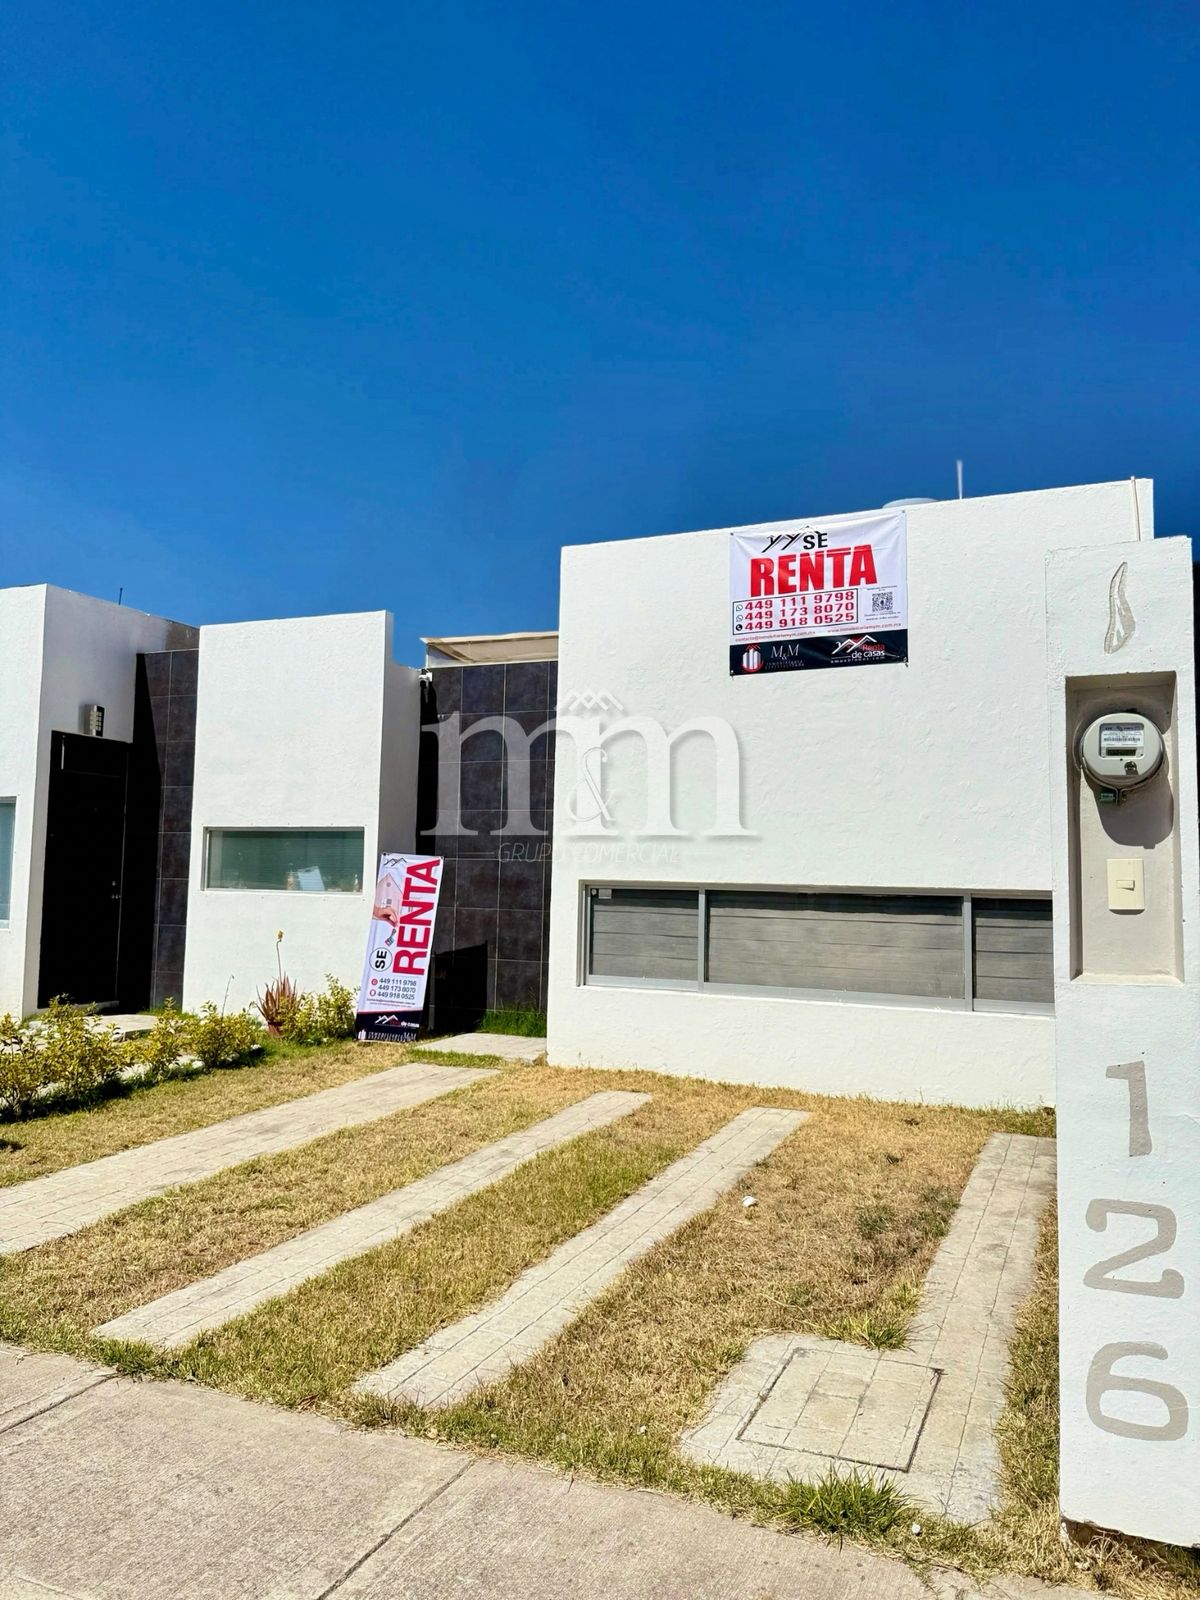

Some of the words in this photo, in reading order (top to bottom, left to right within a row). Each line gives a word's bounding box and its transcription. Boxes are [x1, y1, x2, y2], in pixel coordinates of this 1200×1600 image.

[803, 532, 828, 550] SE
[751, 544, 877, 597] RENTA
[745, 600, 773, 611] 449
[780, 596, 807, 607] 111
[814, 591, 854, 604] 9798
[745, 610, 773, 621] 449
[780, 607, 808, 618] 173
[814, 602, 854, 615] 8070
[745, 620, 773, 631] 449
[779, 617, 808, 628] 918
[814, 612, 854, 624] 0525
[851, 650, 863, 659] de
[392, 858, 441, 975] RENTA
[375, 950, 387, 969] SE
[1083, 1060, 1189, 1442] 126
